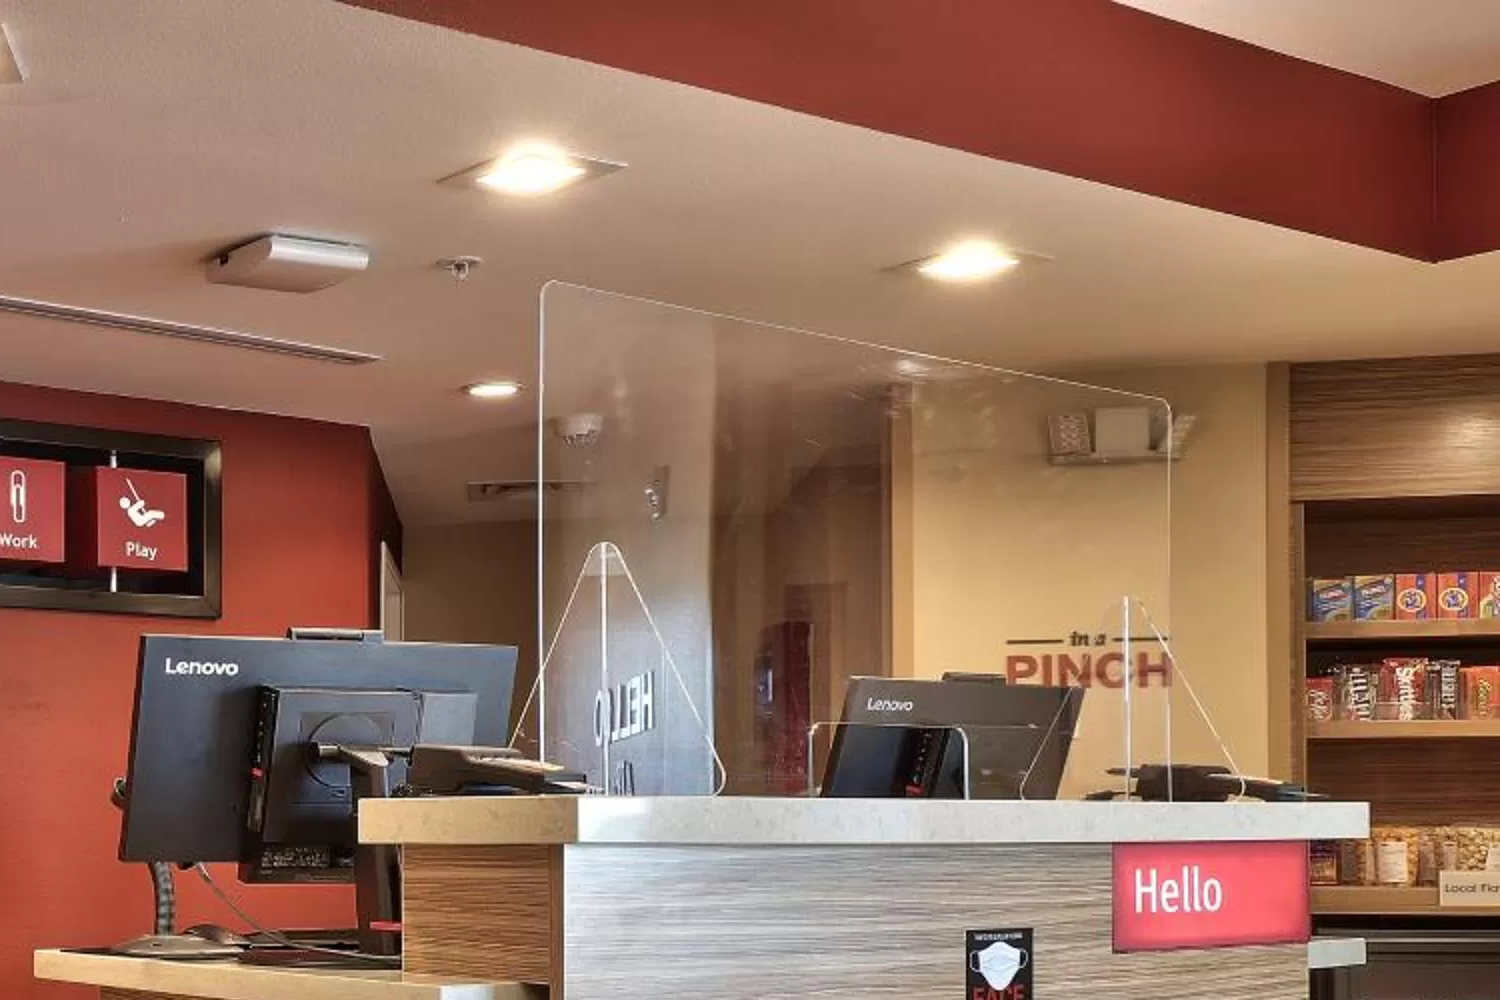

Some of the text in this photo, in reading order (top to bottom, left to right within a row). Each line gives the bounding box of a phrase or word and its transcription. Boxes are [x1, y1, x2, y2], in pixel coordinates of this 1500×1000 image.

[126, 541, 158, 560] Play
[1069, 631, 1108, 647] in a
[165, 657, 239, 676] Lenovo
[1006, 651, 1173, 689] PINCH
[867, 697, 913, 711] Lenovo
[1134, 864, 1223, 914] Hello
